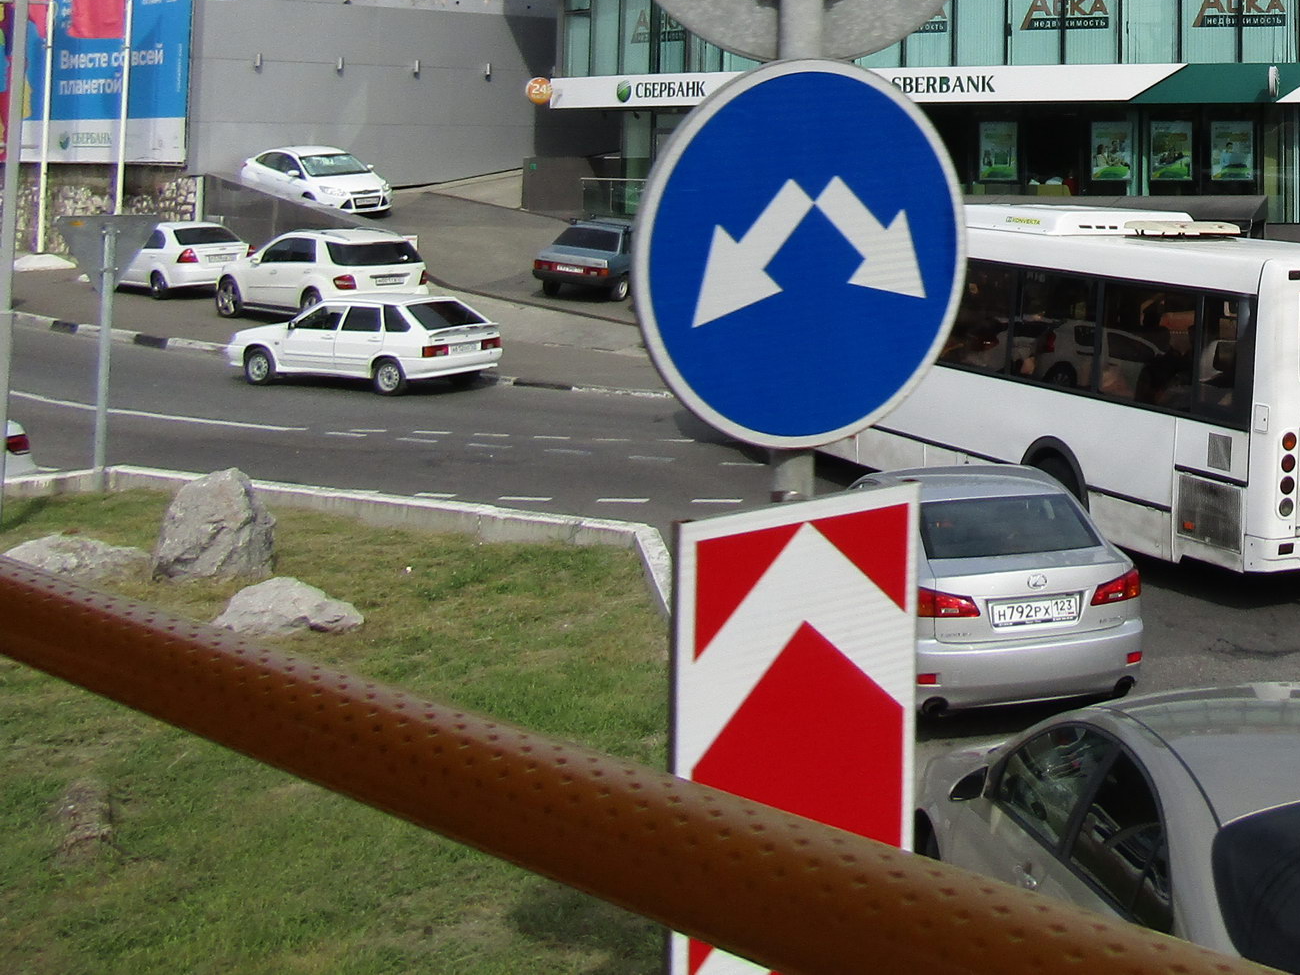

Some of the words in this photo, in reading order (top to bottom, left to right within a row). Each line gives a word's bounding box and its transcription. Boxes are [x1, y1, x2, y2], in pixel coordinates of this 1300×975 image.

[60, 49, 108, 70] Вместе
[131, 43, 164, 67] всей
[59, 73, 123, 96] планетой
[635, 81, 706, 99] СБЕРБАНК
[892, 75, 996, 93] SBERBANK
[1054, 599, 1073, 612] 123
